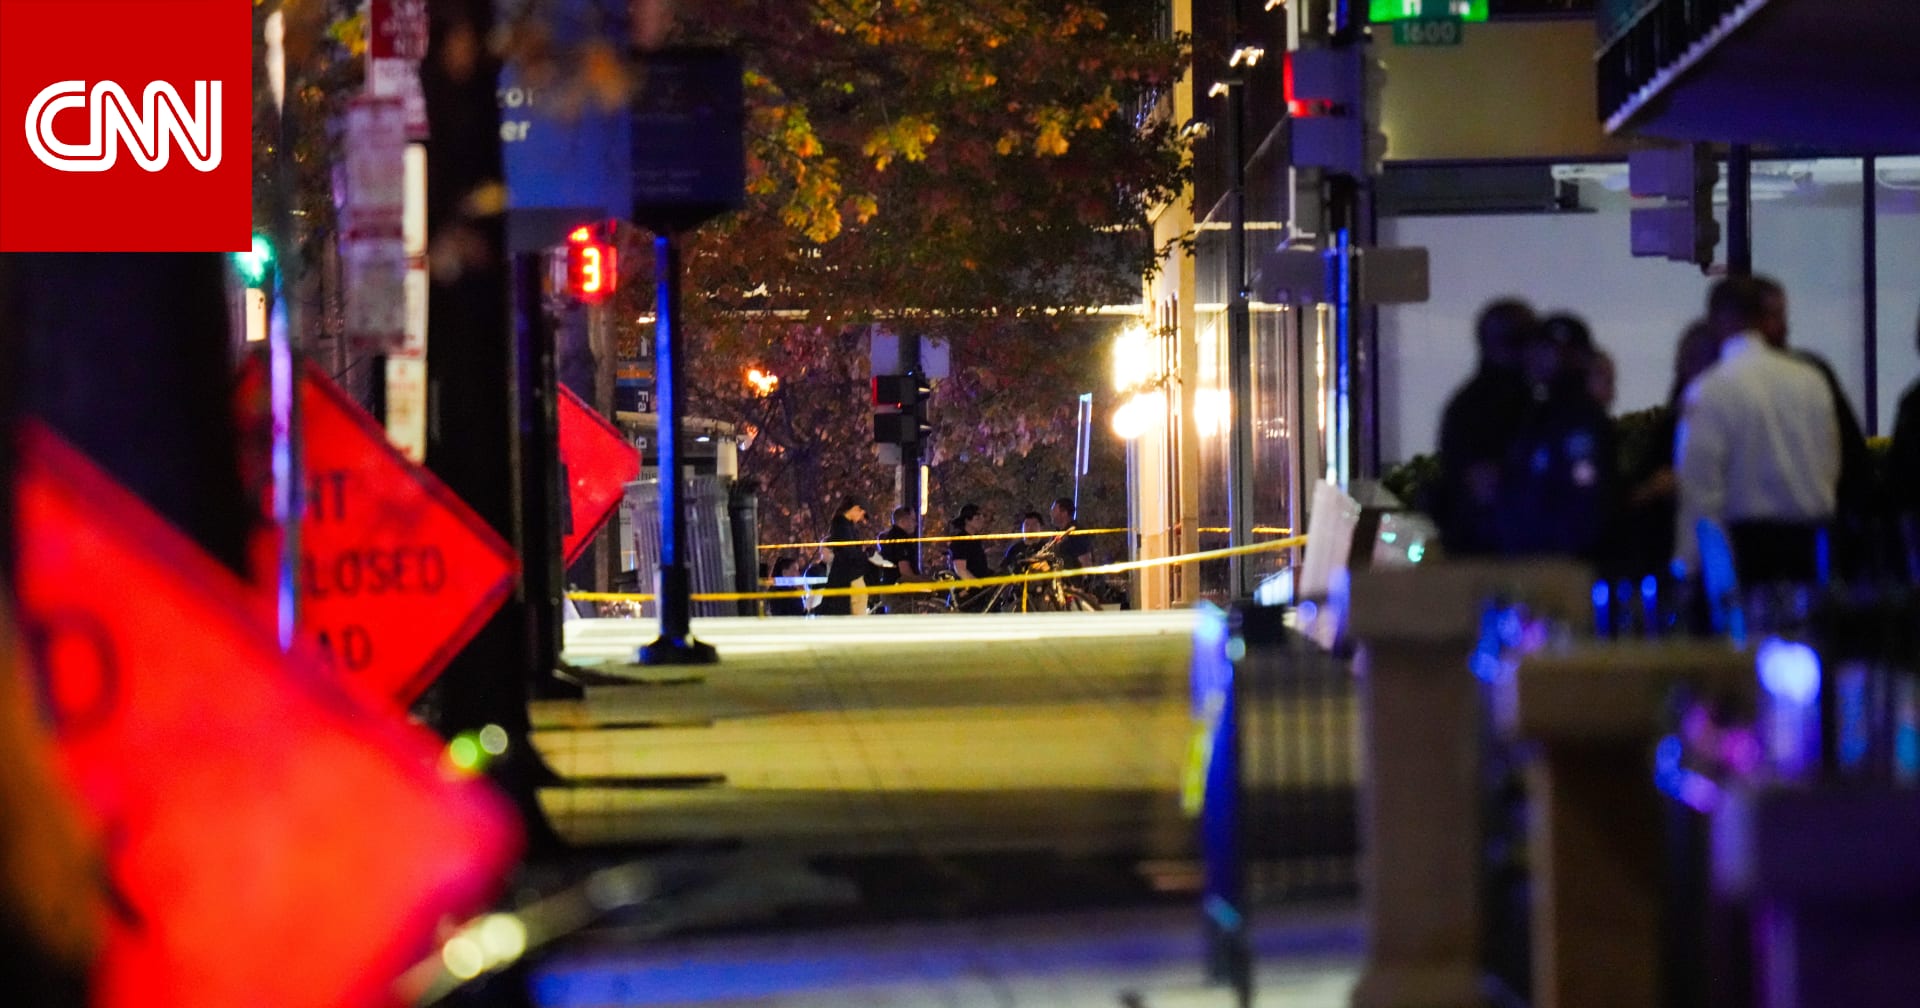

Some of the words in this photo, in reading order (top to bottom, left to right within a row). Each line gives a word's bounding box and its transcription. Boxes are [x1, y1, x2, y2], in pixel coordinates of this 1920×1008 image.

[1403, 20, 1455, 43] 1600
[582, 246, 601, 293] 3
[303, 545, 448, 598] LOSED
